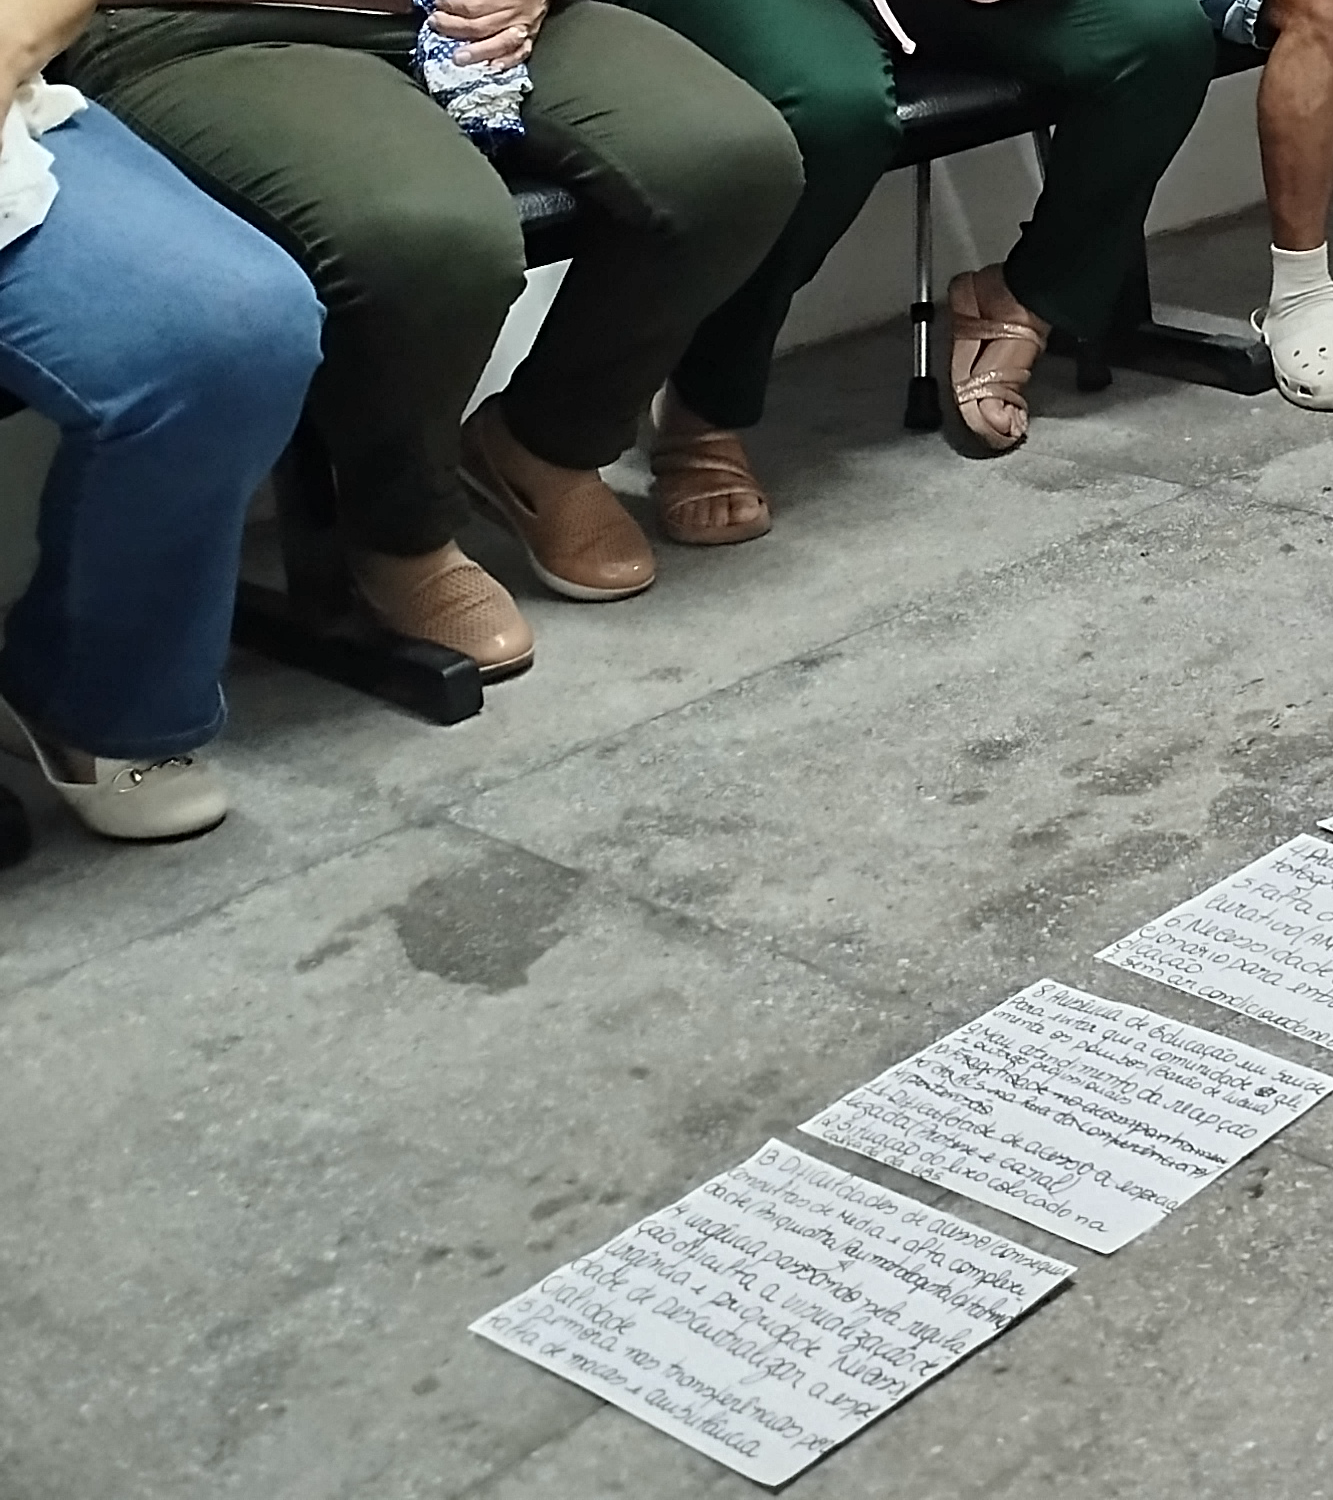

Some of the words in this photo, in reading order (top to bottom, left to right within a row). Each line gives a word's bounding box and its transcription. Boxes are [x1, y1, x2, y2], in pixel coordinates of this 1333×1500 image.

[1248, 882, 1313, 915] Falta
[1093, 1028, 1134, 1046] que
[986, 1176, 1072, 1217] colocado
